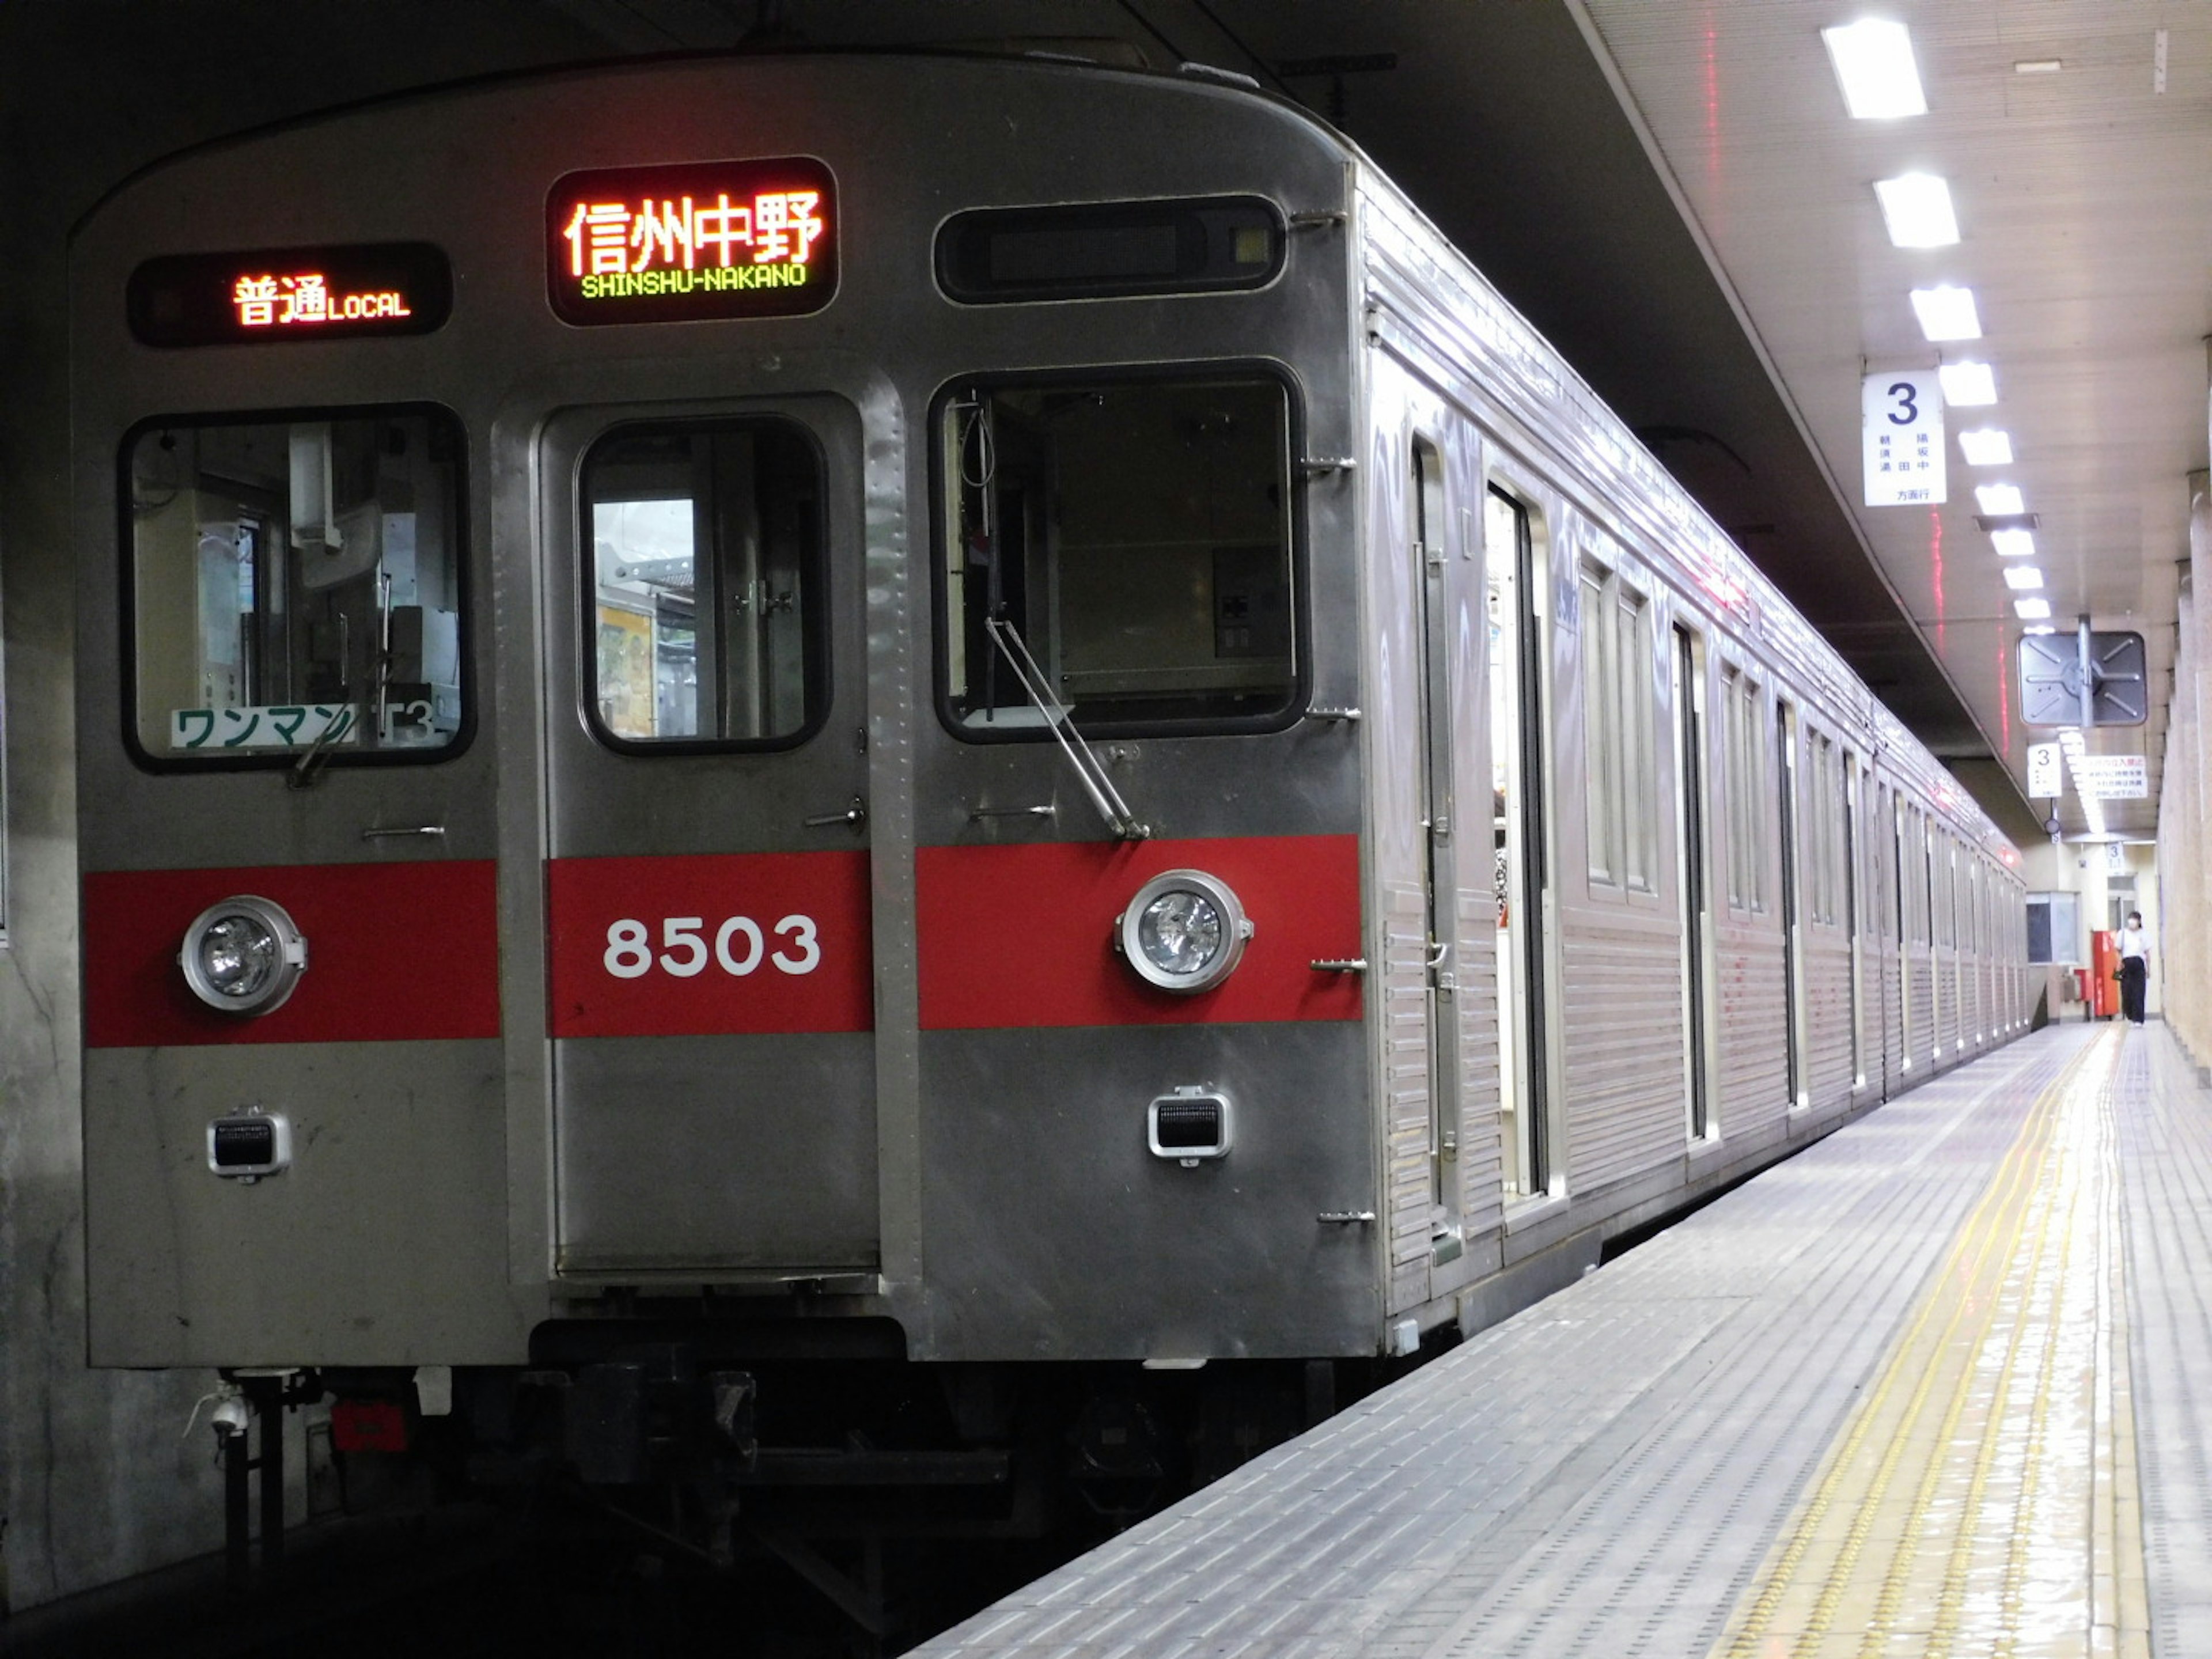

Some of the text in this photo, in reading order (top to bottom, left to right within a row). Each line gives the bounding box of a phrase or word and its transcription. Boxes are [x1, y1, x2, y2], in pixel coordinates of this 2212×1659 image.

[563, 191, 823, 276] 信州中野
[233, 274, 327, 325] 普通
[581, 263, 806, 298] SHINSHU-NAKANO
[328, 293, 411, 321] LOCAL
[1887, 382, 1918, 426] 3
[179, 706, 351, 748] ワンマン
[370, 699, 435, 744] T3
[2037, 749, 2050, 767] 3
[603, 914, 821, 979] 8503
